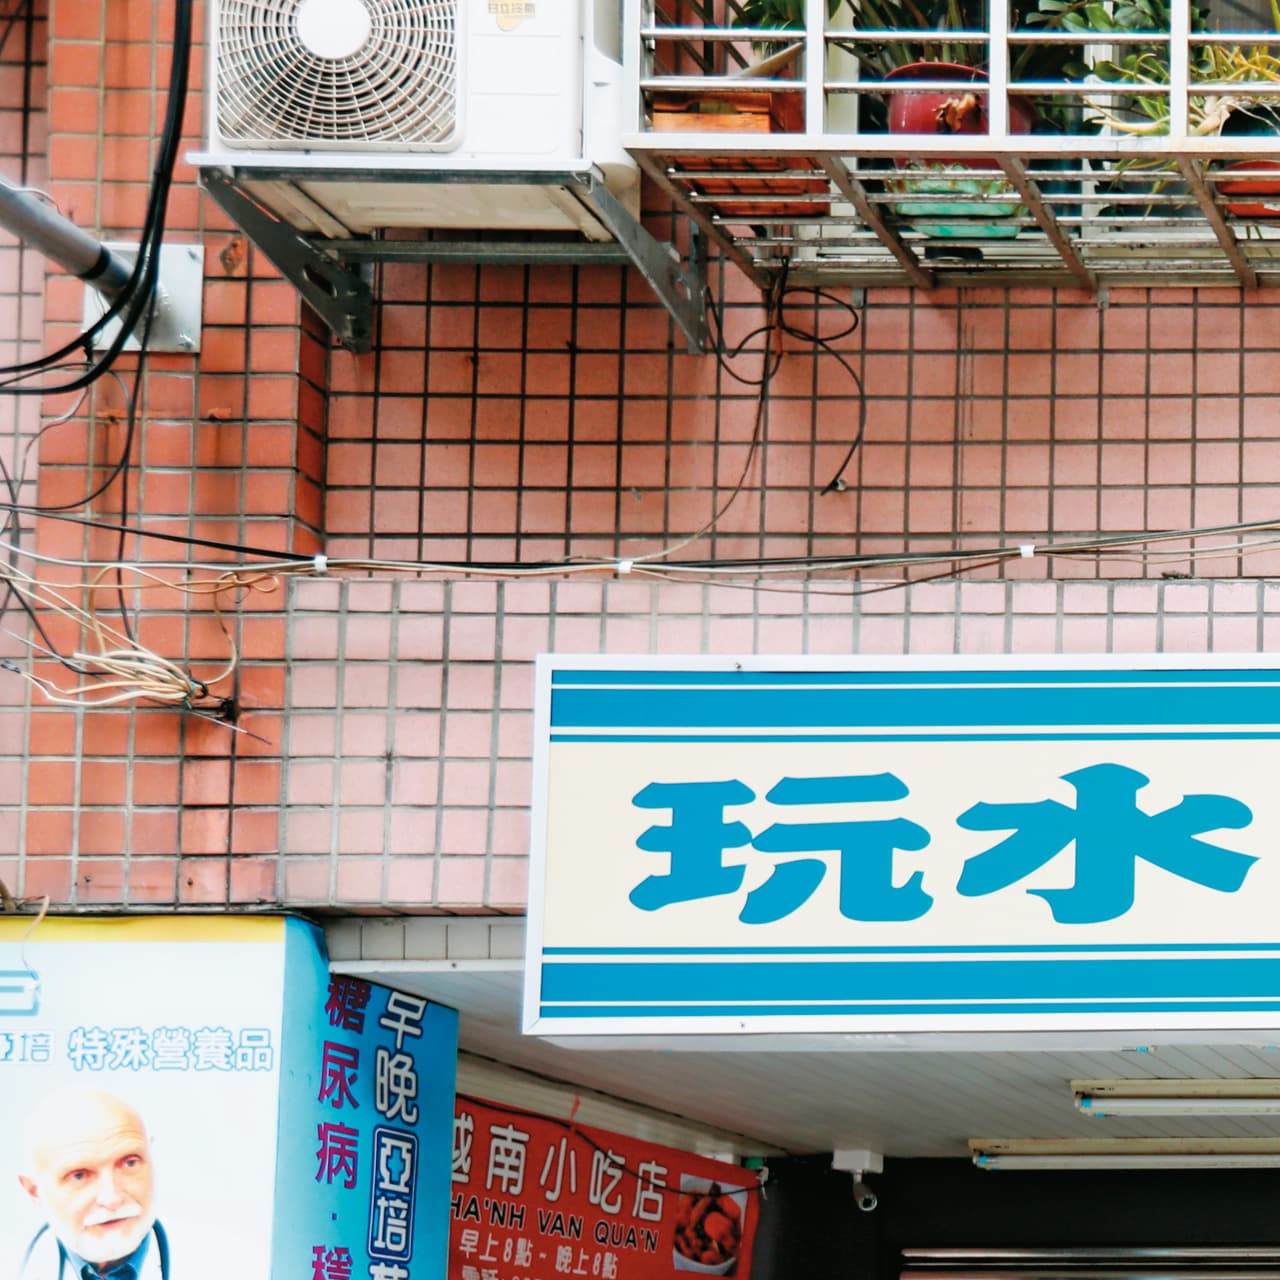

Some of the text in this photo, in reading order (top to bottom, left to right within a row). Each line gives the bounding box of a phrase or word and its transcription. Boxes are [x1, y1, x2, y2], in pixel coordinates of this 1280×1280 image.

[68, 1027, 273, 1071] 特殊營養品
[538, 1209, 583, 1239] VAN
